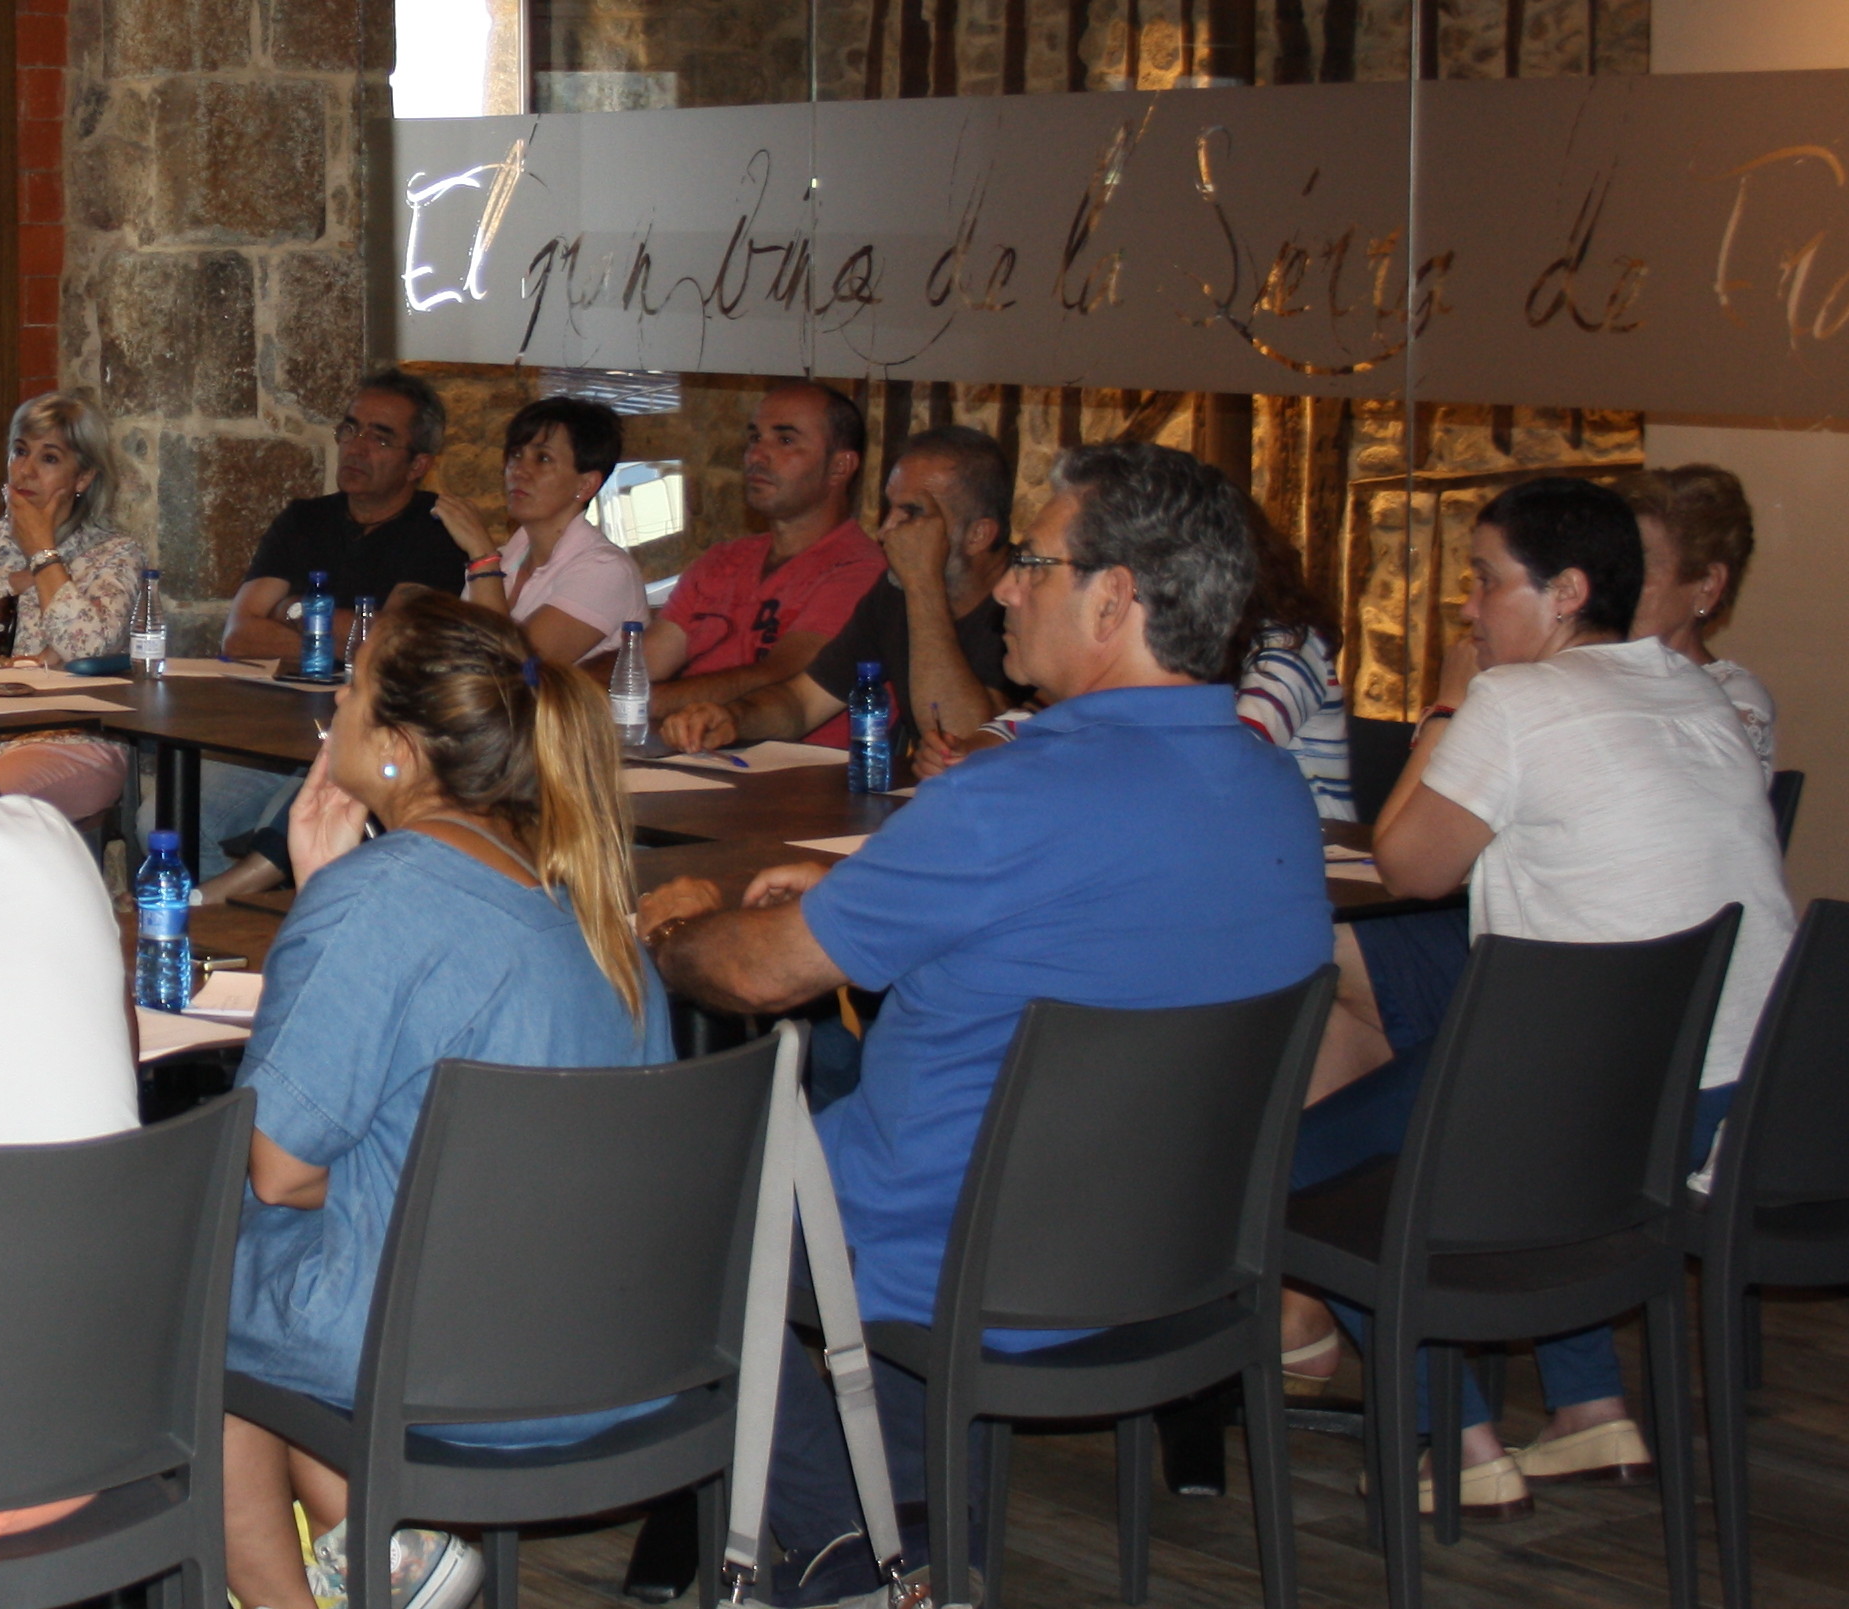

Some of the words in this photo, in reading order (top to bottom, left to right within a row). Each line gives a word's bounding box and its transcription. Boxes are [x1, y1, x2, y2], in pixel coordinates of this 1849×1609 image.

[402, 136, 526, 315] El
[925, 165, 1018, 313] de
[1052, 118, 1126, 318] la
[1525, 165, 1648, 333] de
